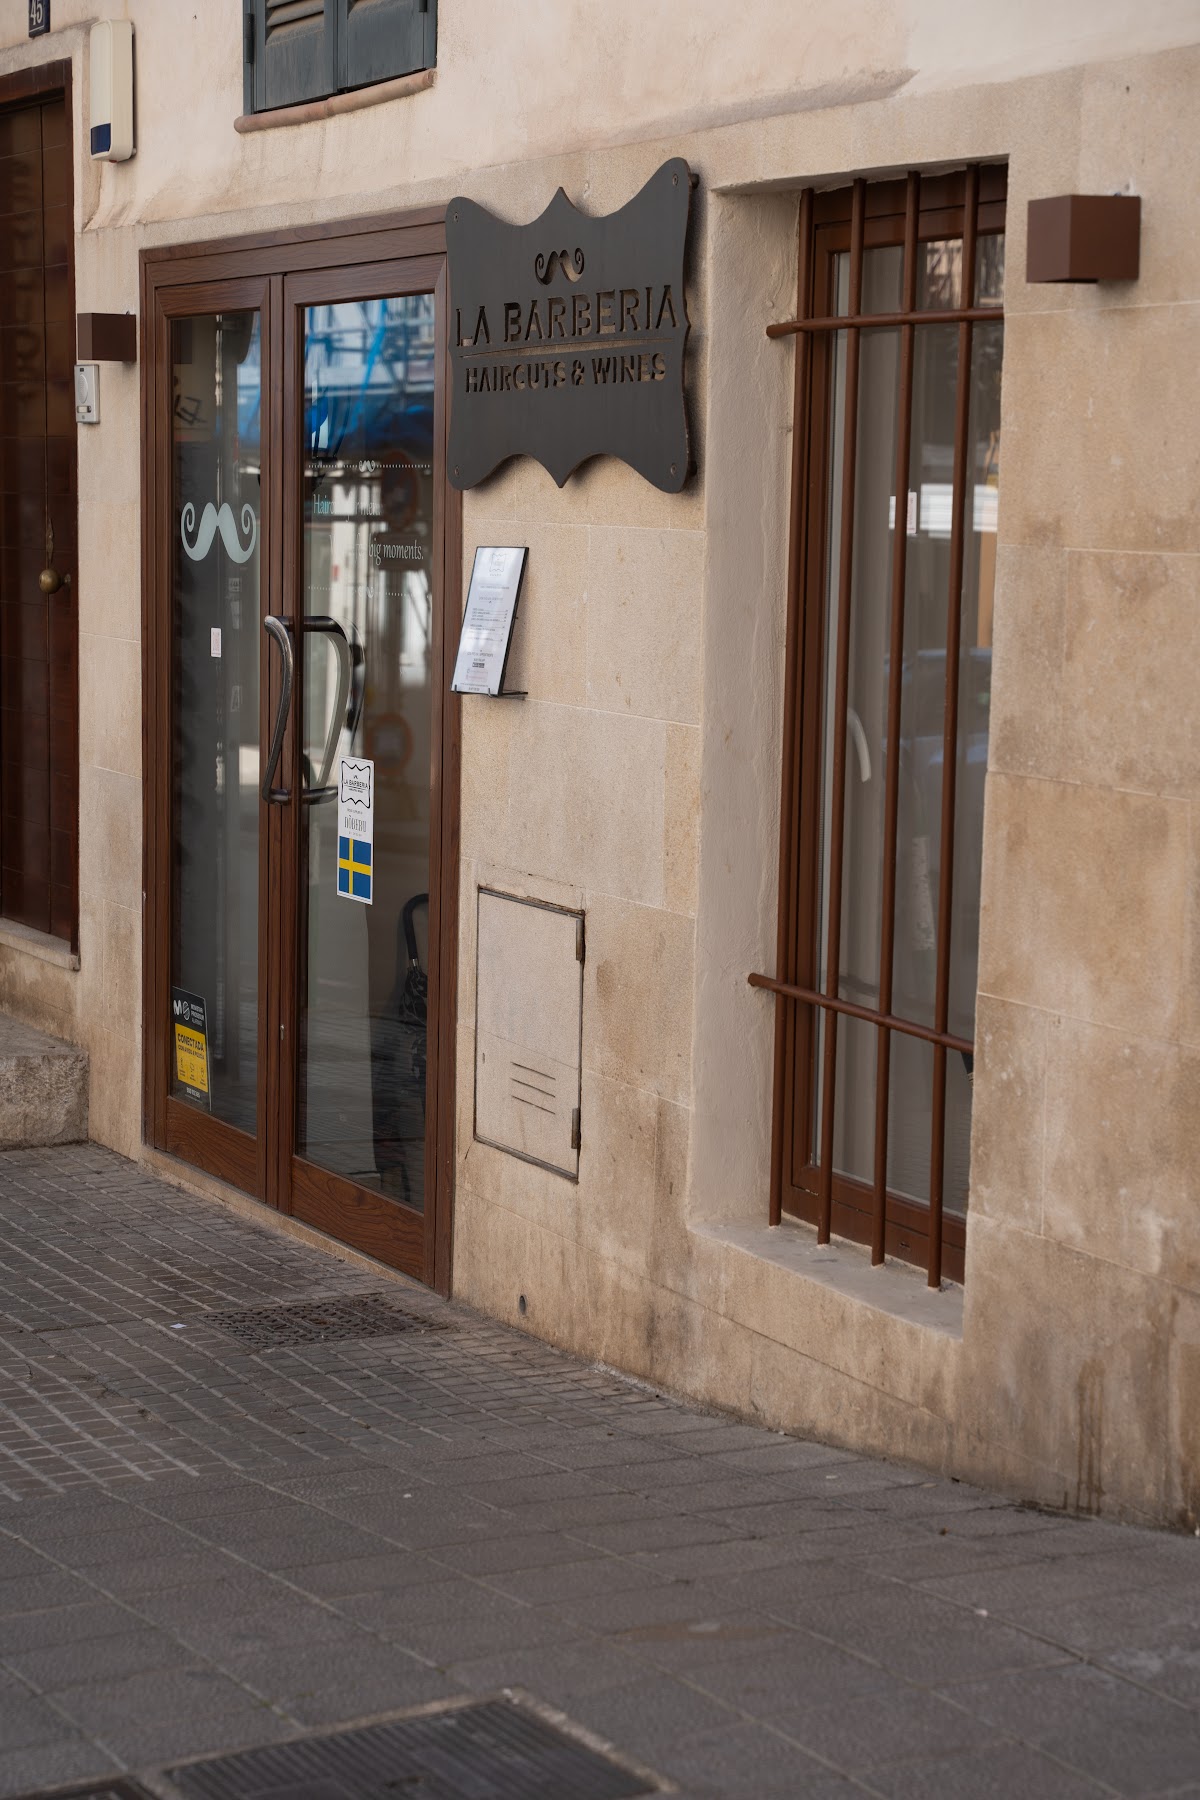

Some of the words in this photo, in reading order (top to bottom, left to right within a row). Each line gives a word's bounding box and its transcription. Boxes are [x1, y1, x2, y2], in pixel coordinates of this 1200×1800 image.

[30, 0, 43, 26] 45
[455, 305, 491, 347] LA
[503, 285, 680, 343] BARBERIA
[465, 361, 566, 393] HAIRCUTS
[571, 359, 585, 386] &
[592, 352, 666, 384] WINES
[368, 533, 382, 566] big
[383, 540, 424, 560] moments.
